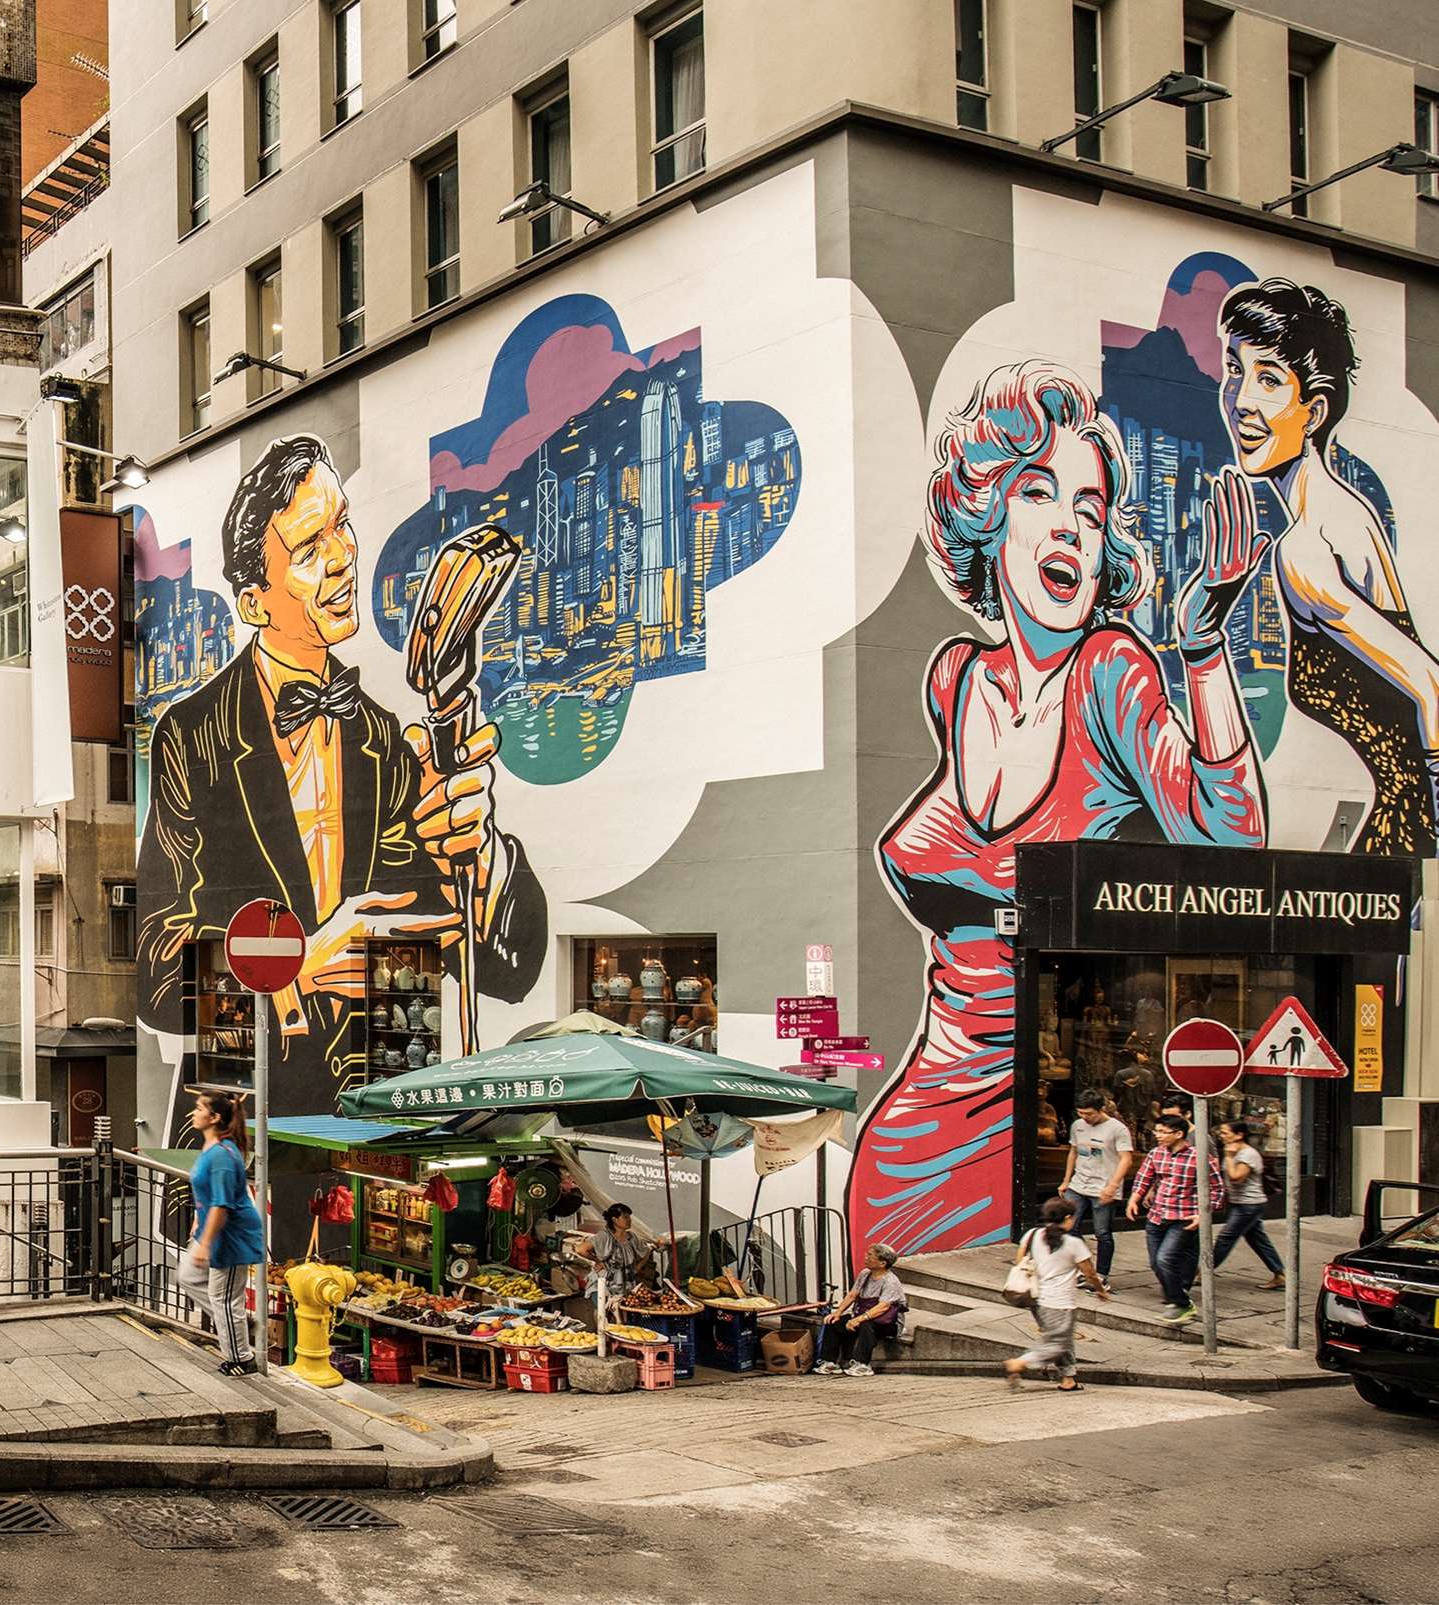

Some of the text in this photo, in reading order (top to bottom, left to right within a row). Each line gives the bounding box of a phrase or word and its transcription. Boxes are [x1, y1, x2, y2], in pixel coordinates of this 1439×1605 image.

[66, 645, 112, 657] madera
[1093, 881, 1401, 926] ARCH ANGEL ANTIQUES
[1358, 1047, 1378, 1056] HOTEL
[609, 1162, 701, 1185] MADERA HOLLWOOD
